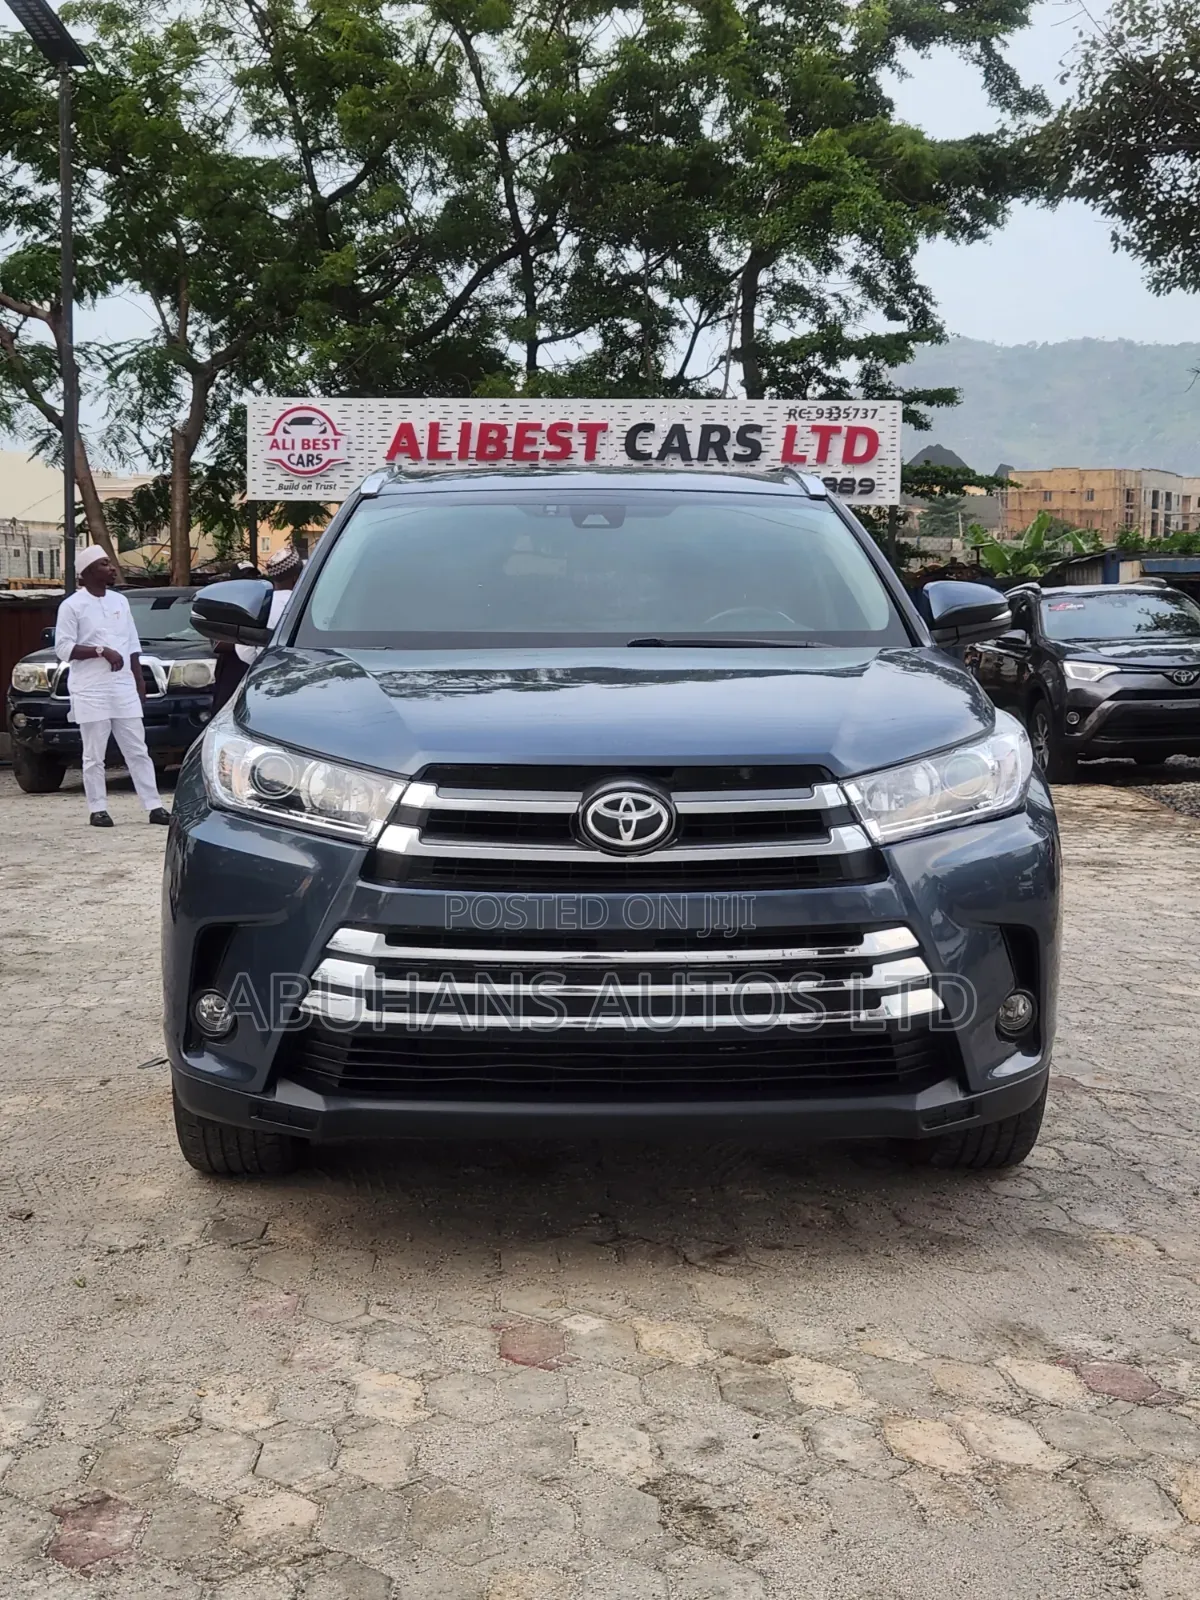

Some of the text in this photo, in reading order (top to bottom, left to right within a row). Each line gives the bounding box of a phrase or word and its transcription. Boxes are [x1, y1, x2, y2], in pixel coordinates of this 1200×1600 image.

[269, 438, 341, 451] ALI BEST
[385, 422, 880, 465] ALIBEST CARS LTD
[287, 453, 323, 468] CARS
[277, 482, 300, 491] Build
[315, 482, 337, 491] Trust
